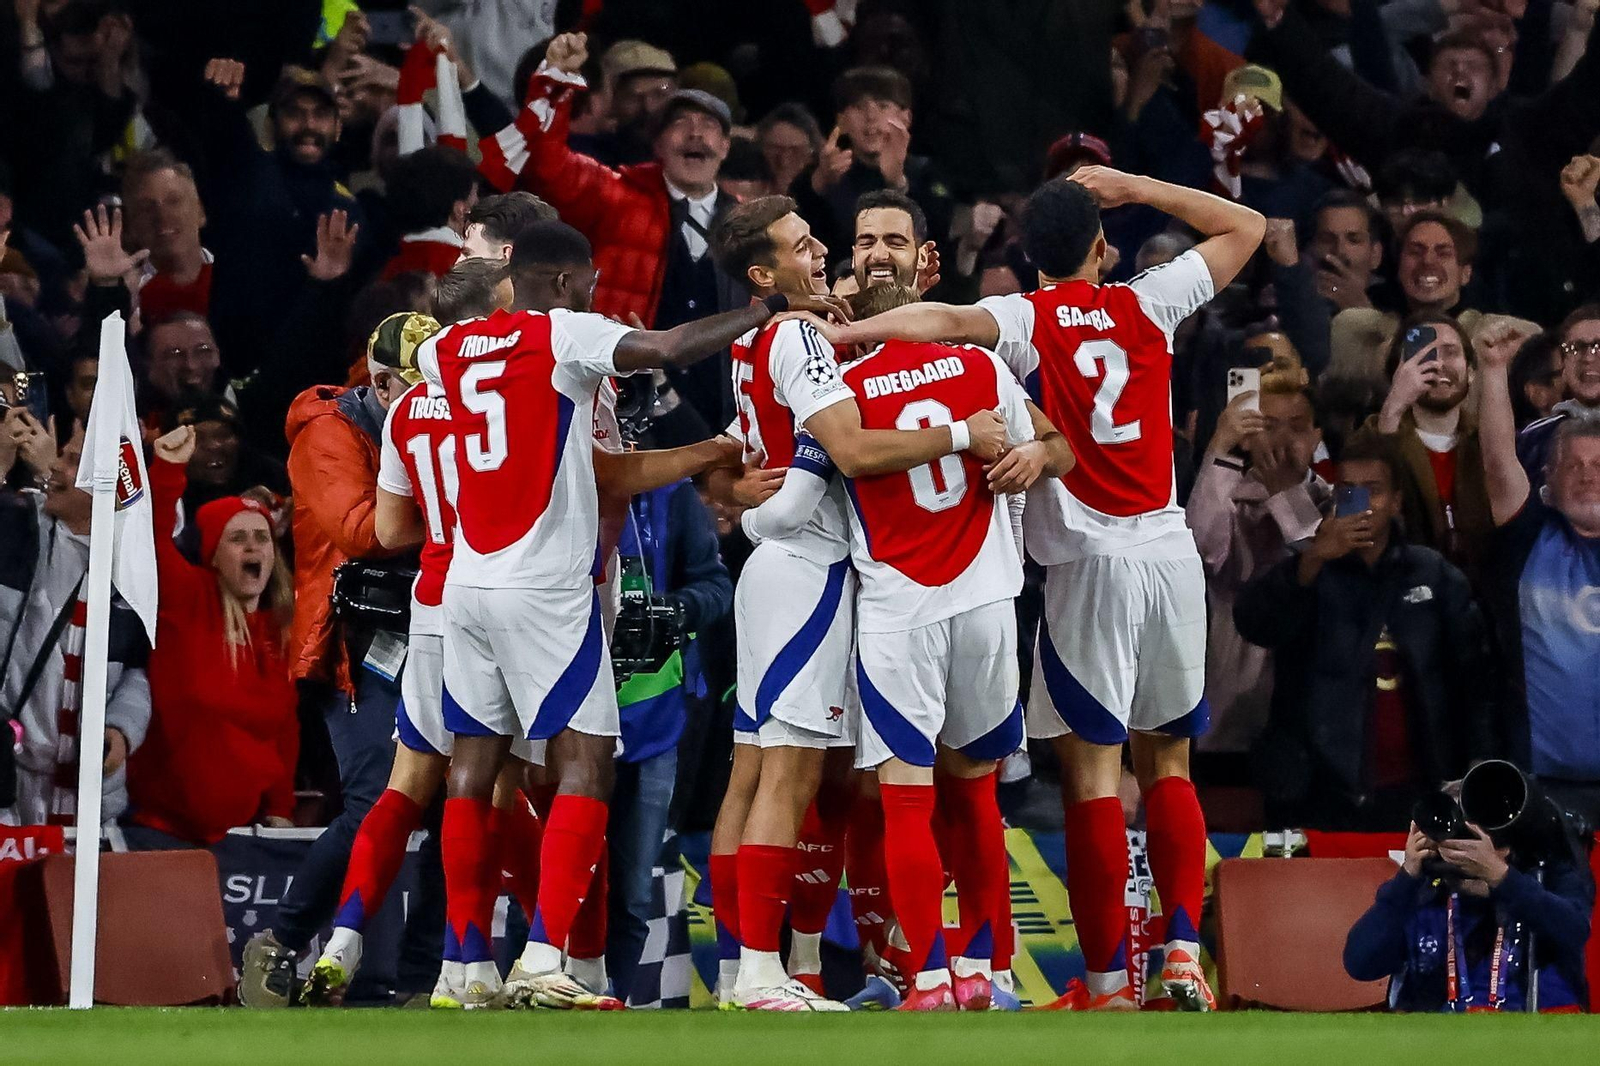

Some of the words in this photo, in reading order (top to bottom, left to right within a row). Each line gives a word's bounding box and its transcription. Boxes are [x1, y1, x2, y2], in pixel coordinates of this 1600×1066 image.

[1056, 305, 1116, 332] SABA
[863, 356, 965, 399] ØDEGAARD
[1073, 338, 1141, 445] 2
[460, 360, 508, 473] 5
[796, 841, 834, 853] AFC
[223, 874, 294, 905] SL
[848, 886, 881, 896] AFC
